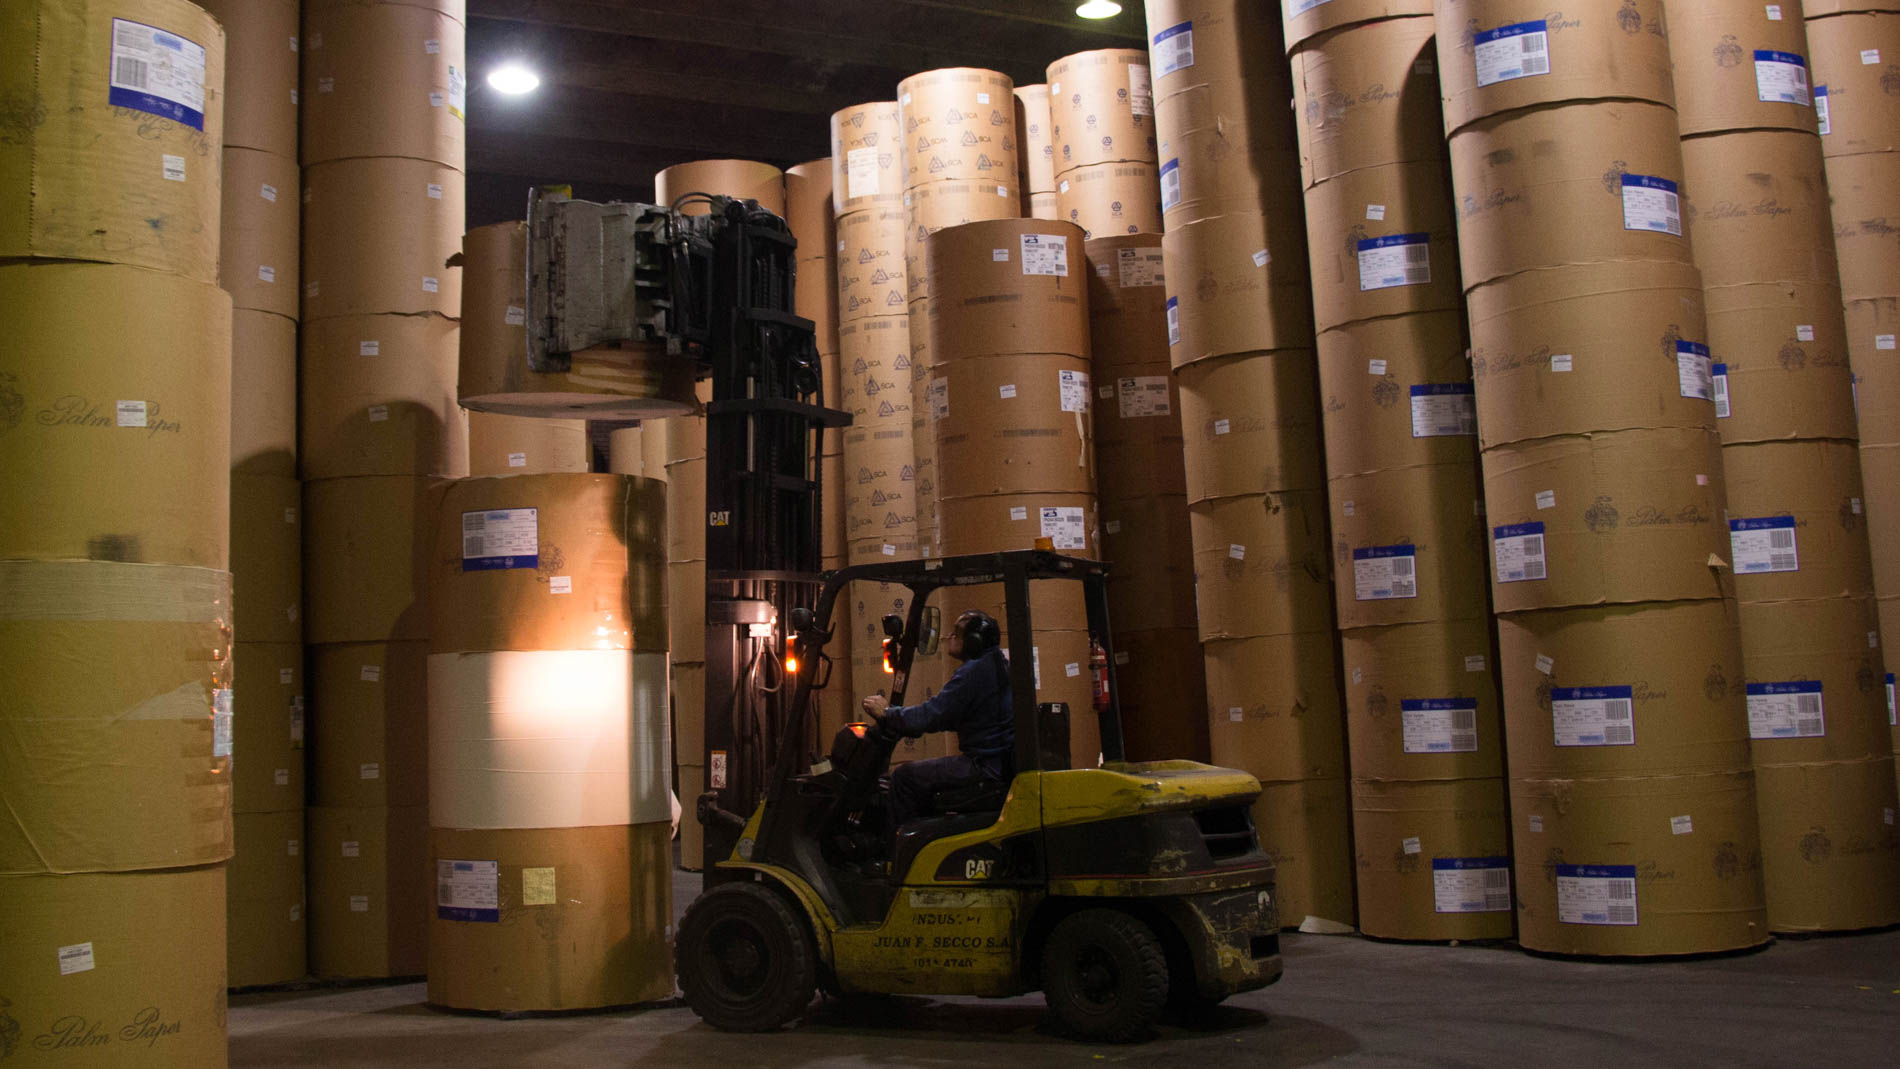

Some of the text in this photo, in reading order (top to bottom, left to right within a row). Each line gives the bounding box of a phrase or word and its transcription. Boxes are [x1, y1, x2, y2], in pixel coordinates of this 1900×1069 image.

[867, 361, 881, 369] SCA
[880, 382, 895, 390] SCA
[37, 395, 113, 428] Palm
[894, 404, 910, 412] SCA
[709, 511, 731, 527] CAT
[901, 515, 915, 523] SCA
[965, 859, 995, 880] CAT
[873, 936, 911, 948] JUAN
[932, 936, 982, 949] SECCO
[33, 1007, 183, 1052] Palm Paper
